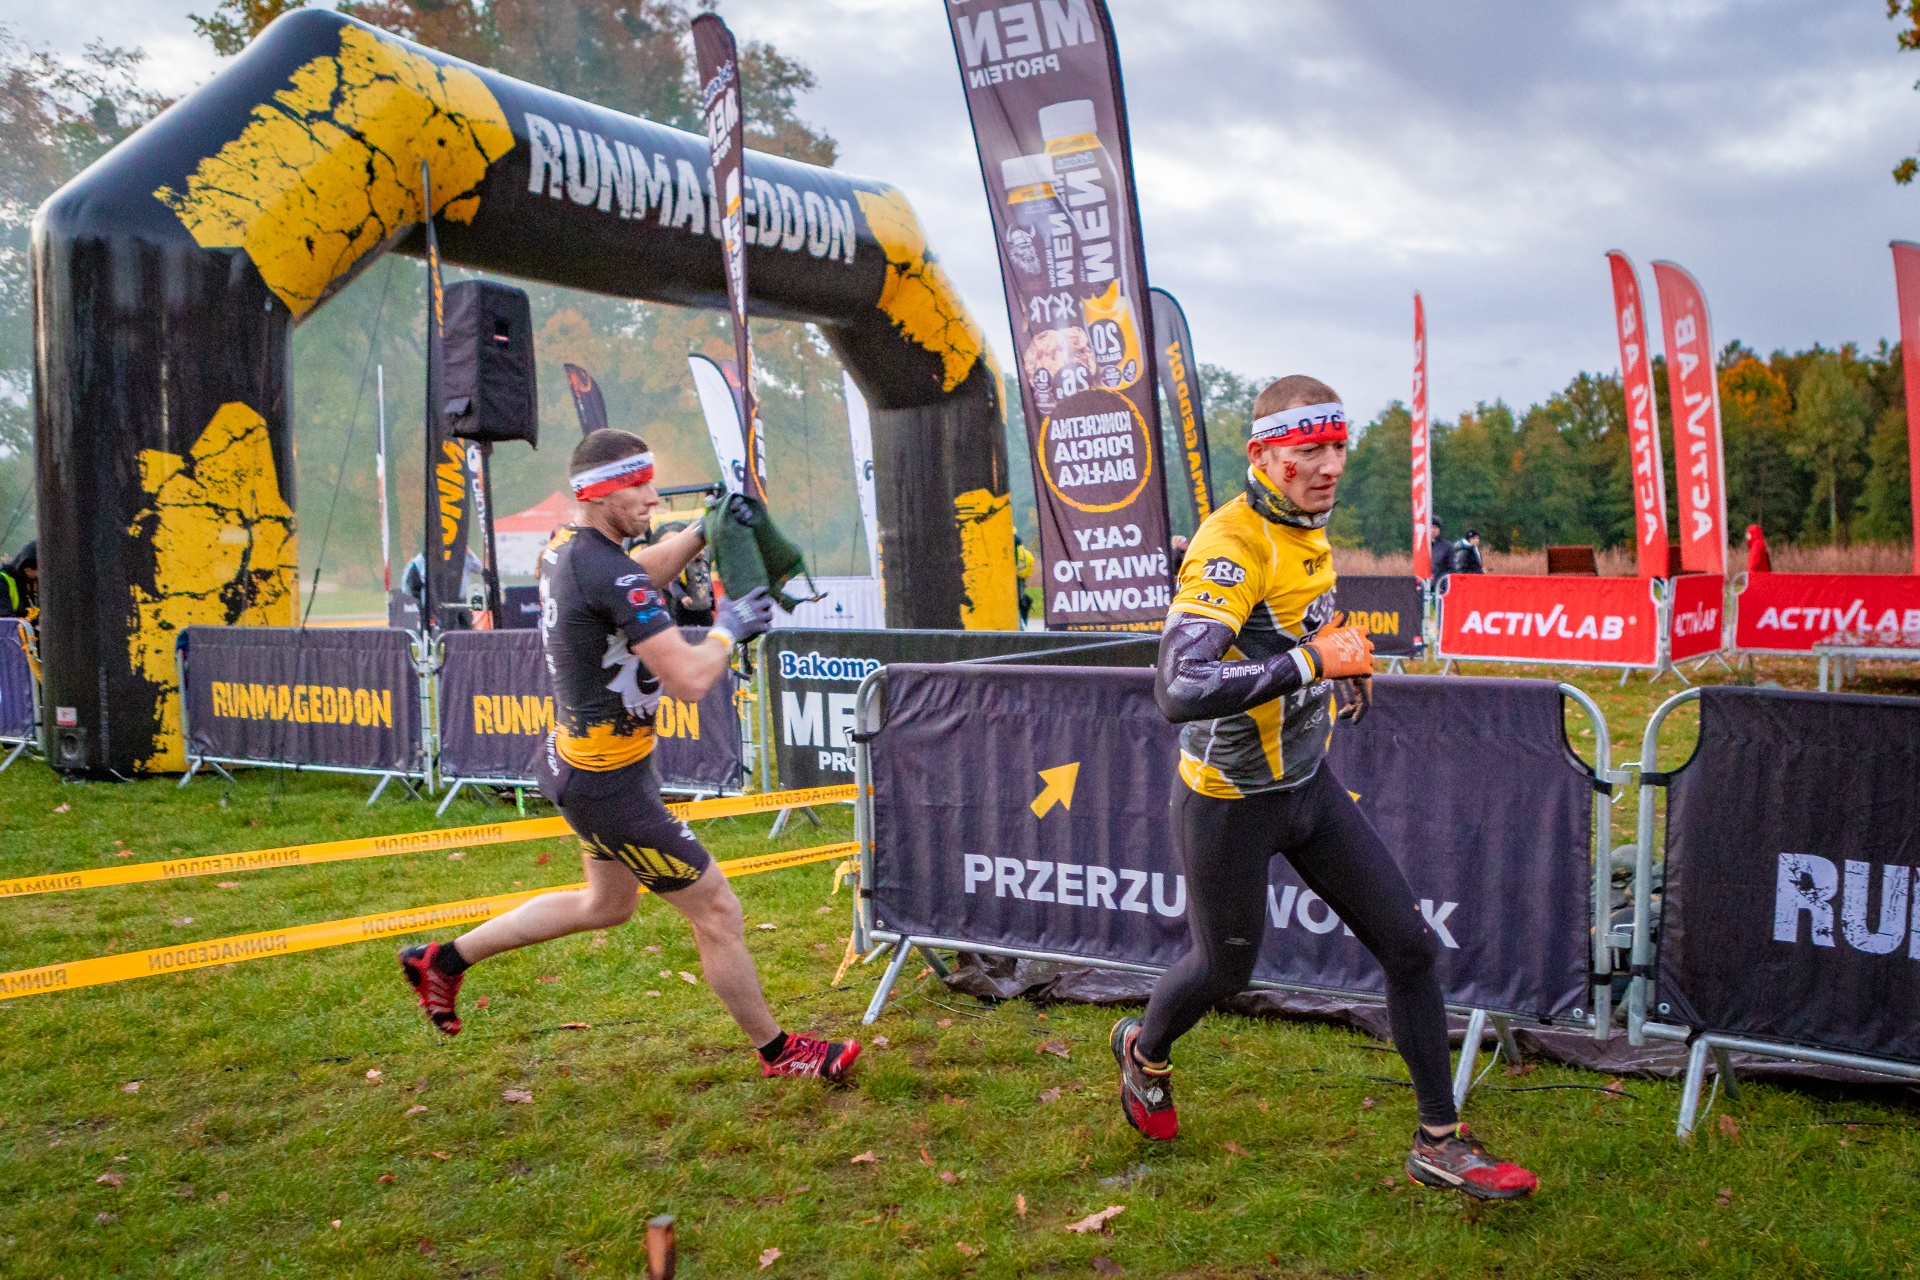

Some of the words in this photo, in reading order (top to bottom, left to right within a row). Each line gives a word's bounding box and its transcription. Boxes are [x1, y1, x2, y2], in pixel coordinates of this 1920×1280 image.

[779, 650, 881, 681] Bakoma
[1221, 663, 1265, 679] SMMASH
[211, 681, 392, 729] RUNMAGEDDON
